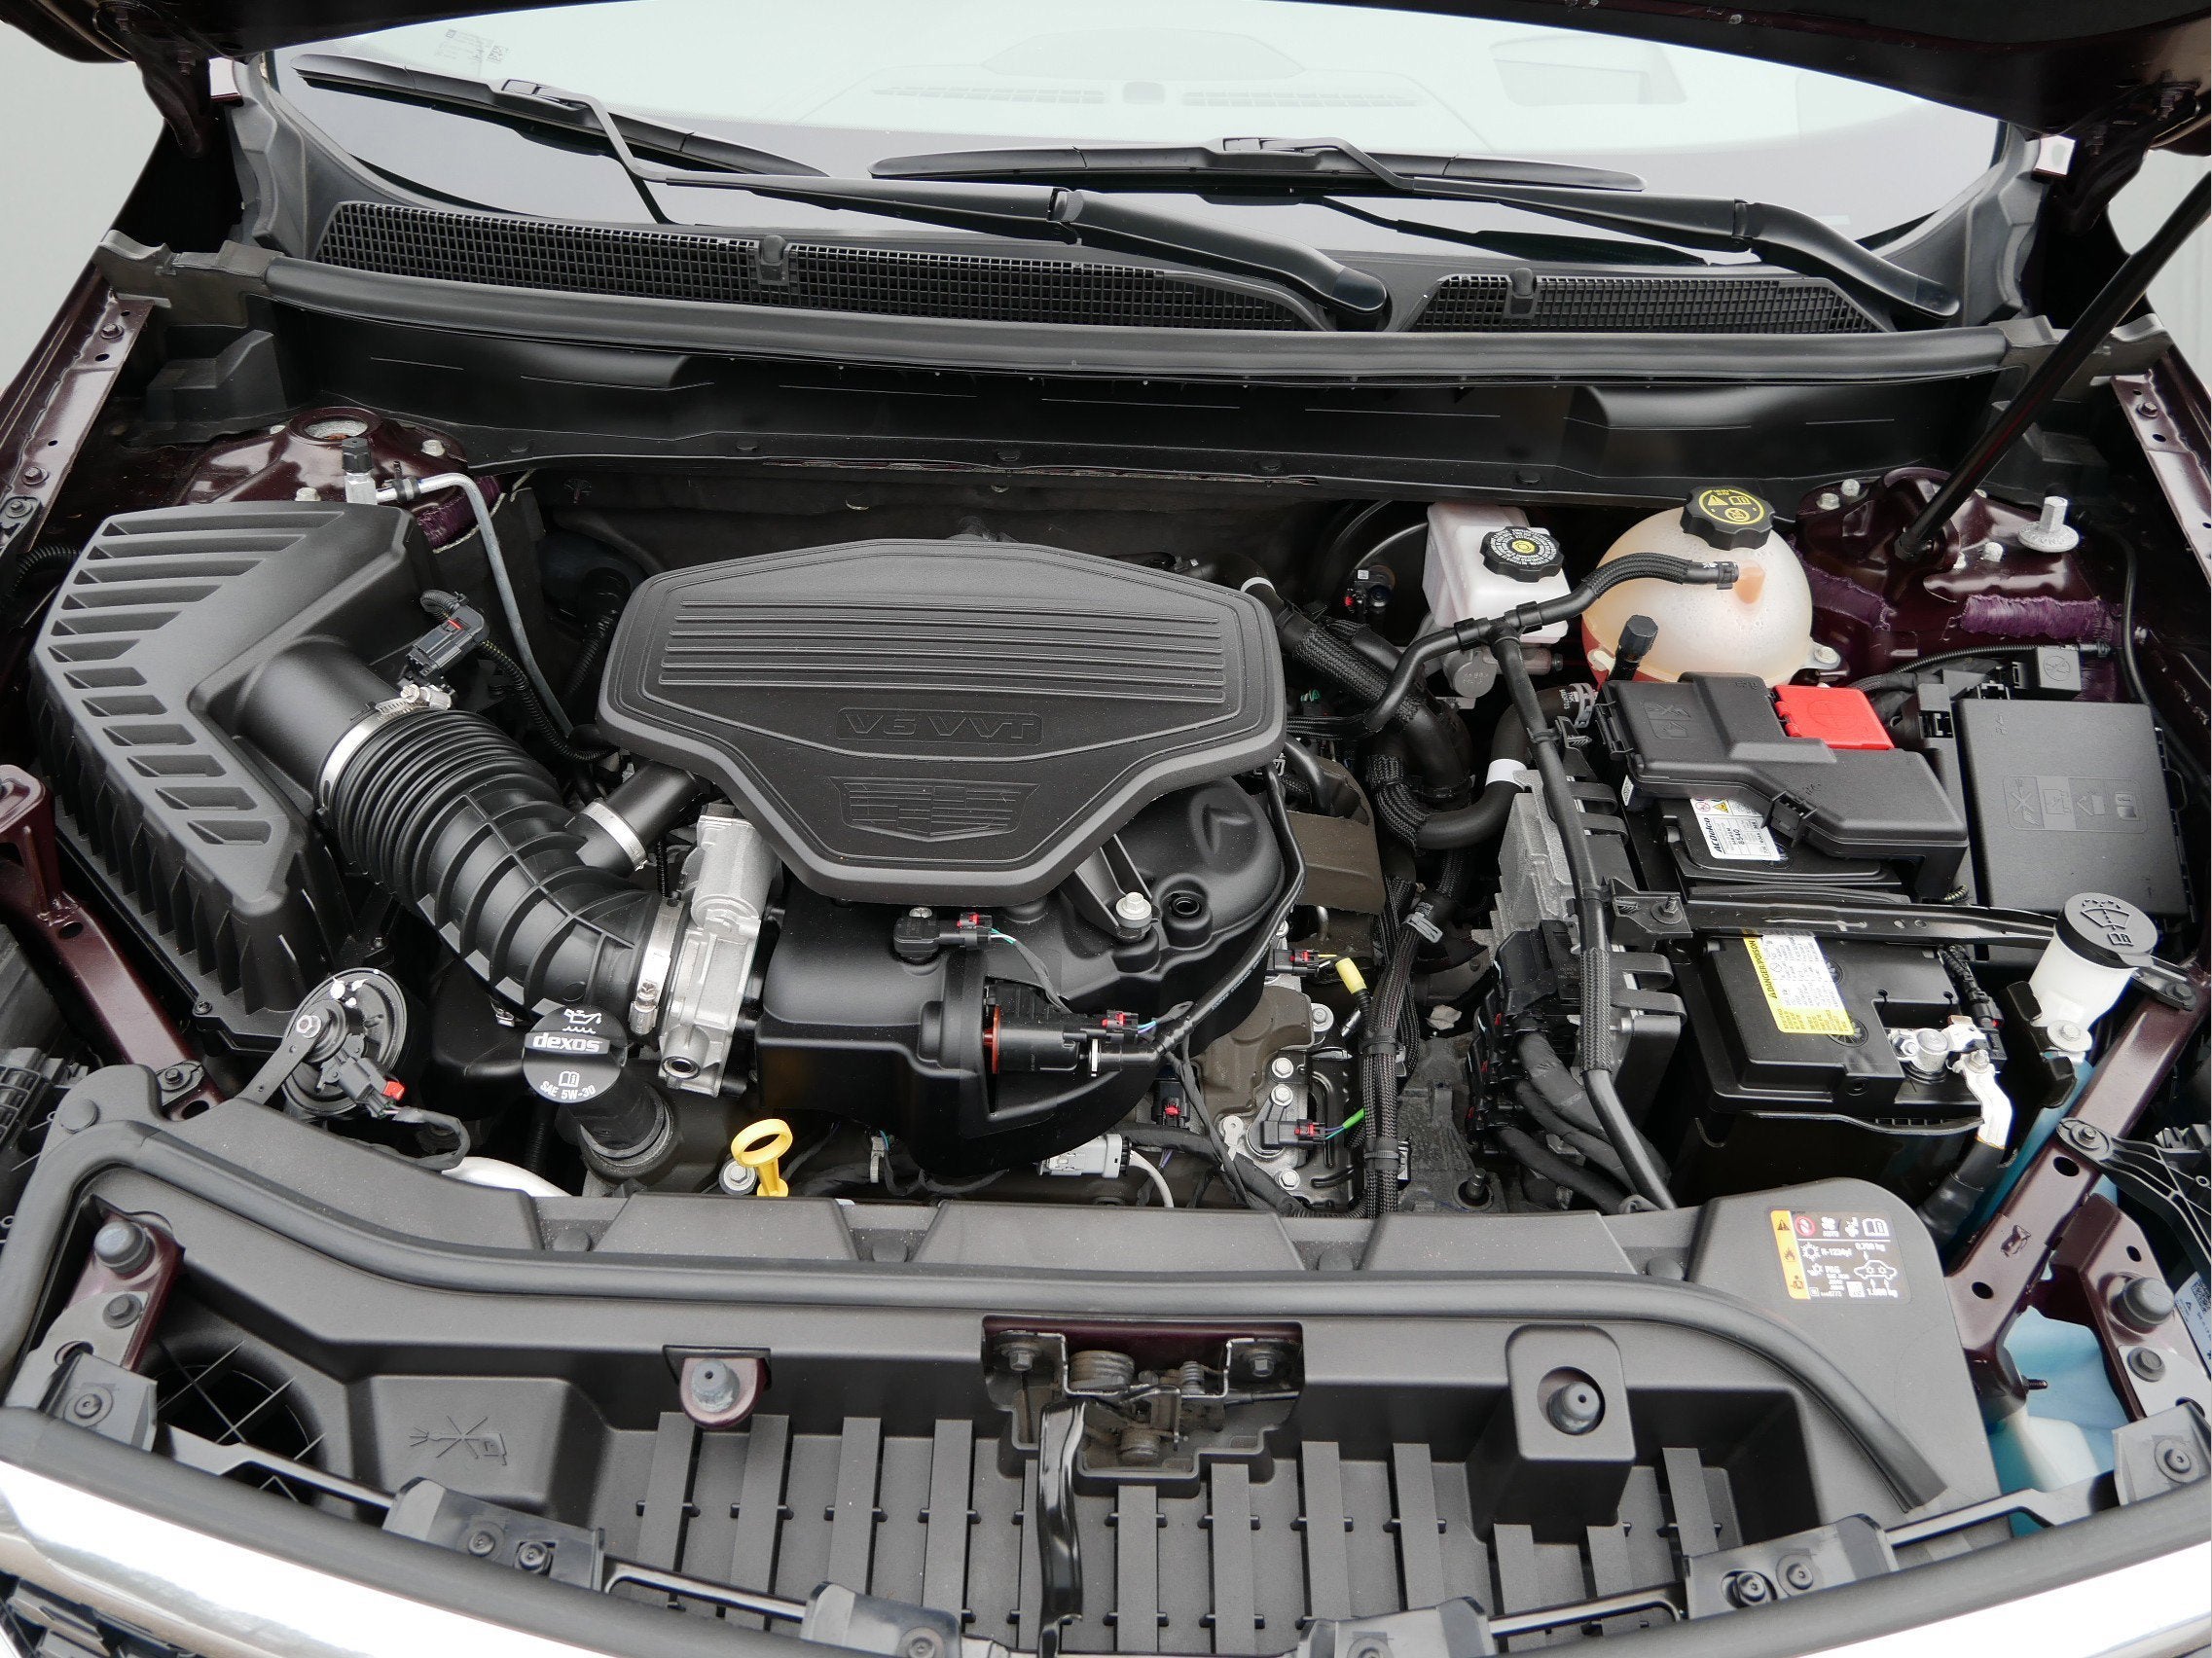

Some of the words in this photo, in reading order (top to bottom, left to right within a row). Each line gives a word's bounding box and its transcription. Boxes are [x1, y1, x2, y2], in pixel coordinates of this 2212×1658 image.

[845, 714, 917, 736] V6
[927, 716, 1034, 739] VVT
[1704, 817, 1722, 852] ACDelco
[532, 1032, 602, 1052] dexos
[540, 1080, 560, 1097] SAE
[561, 1084, 597, 1099] 5W-30
